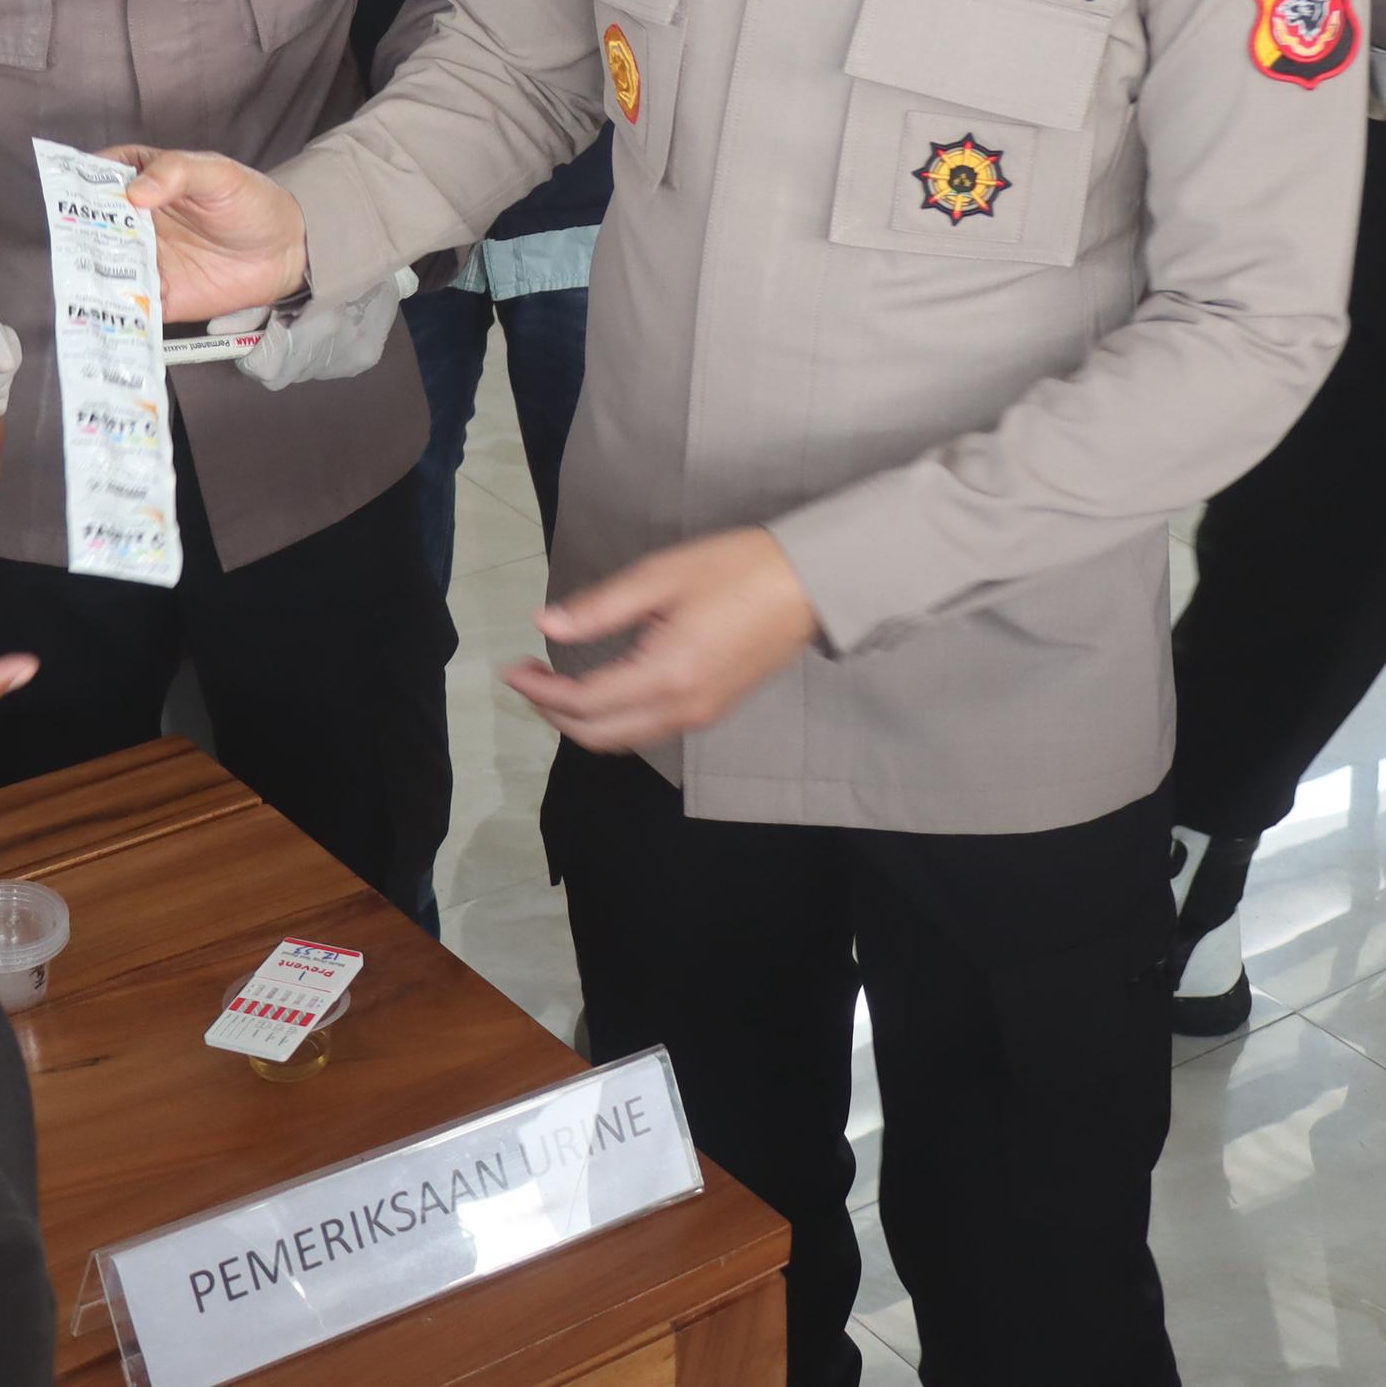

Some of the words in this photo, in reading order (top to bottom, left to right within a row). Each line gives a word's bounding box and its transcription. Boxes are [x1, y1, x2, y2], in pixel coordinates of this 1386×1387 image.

[58, 200, 117, 225] FASFIT
[124, 215, 135, 229] C
[189, 338, 231, 351] Permanent
[188, 1151, 509, 1314] PEMERIKSAAN
[519, 1095, 653, 1181] URINE
